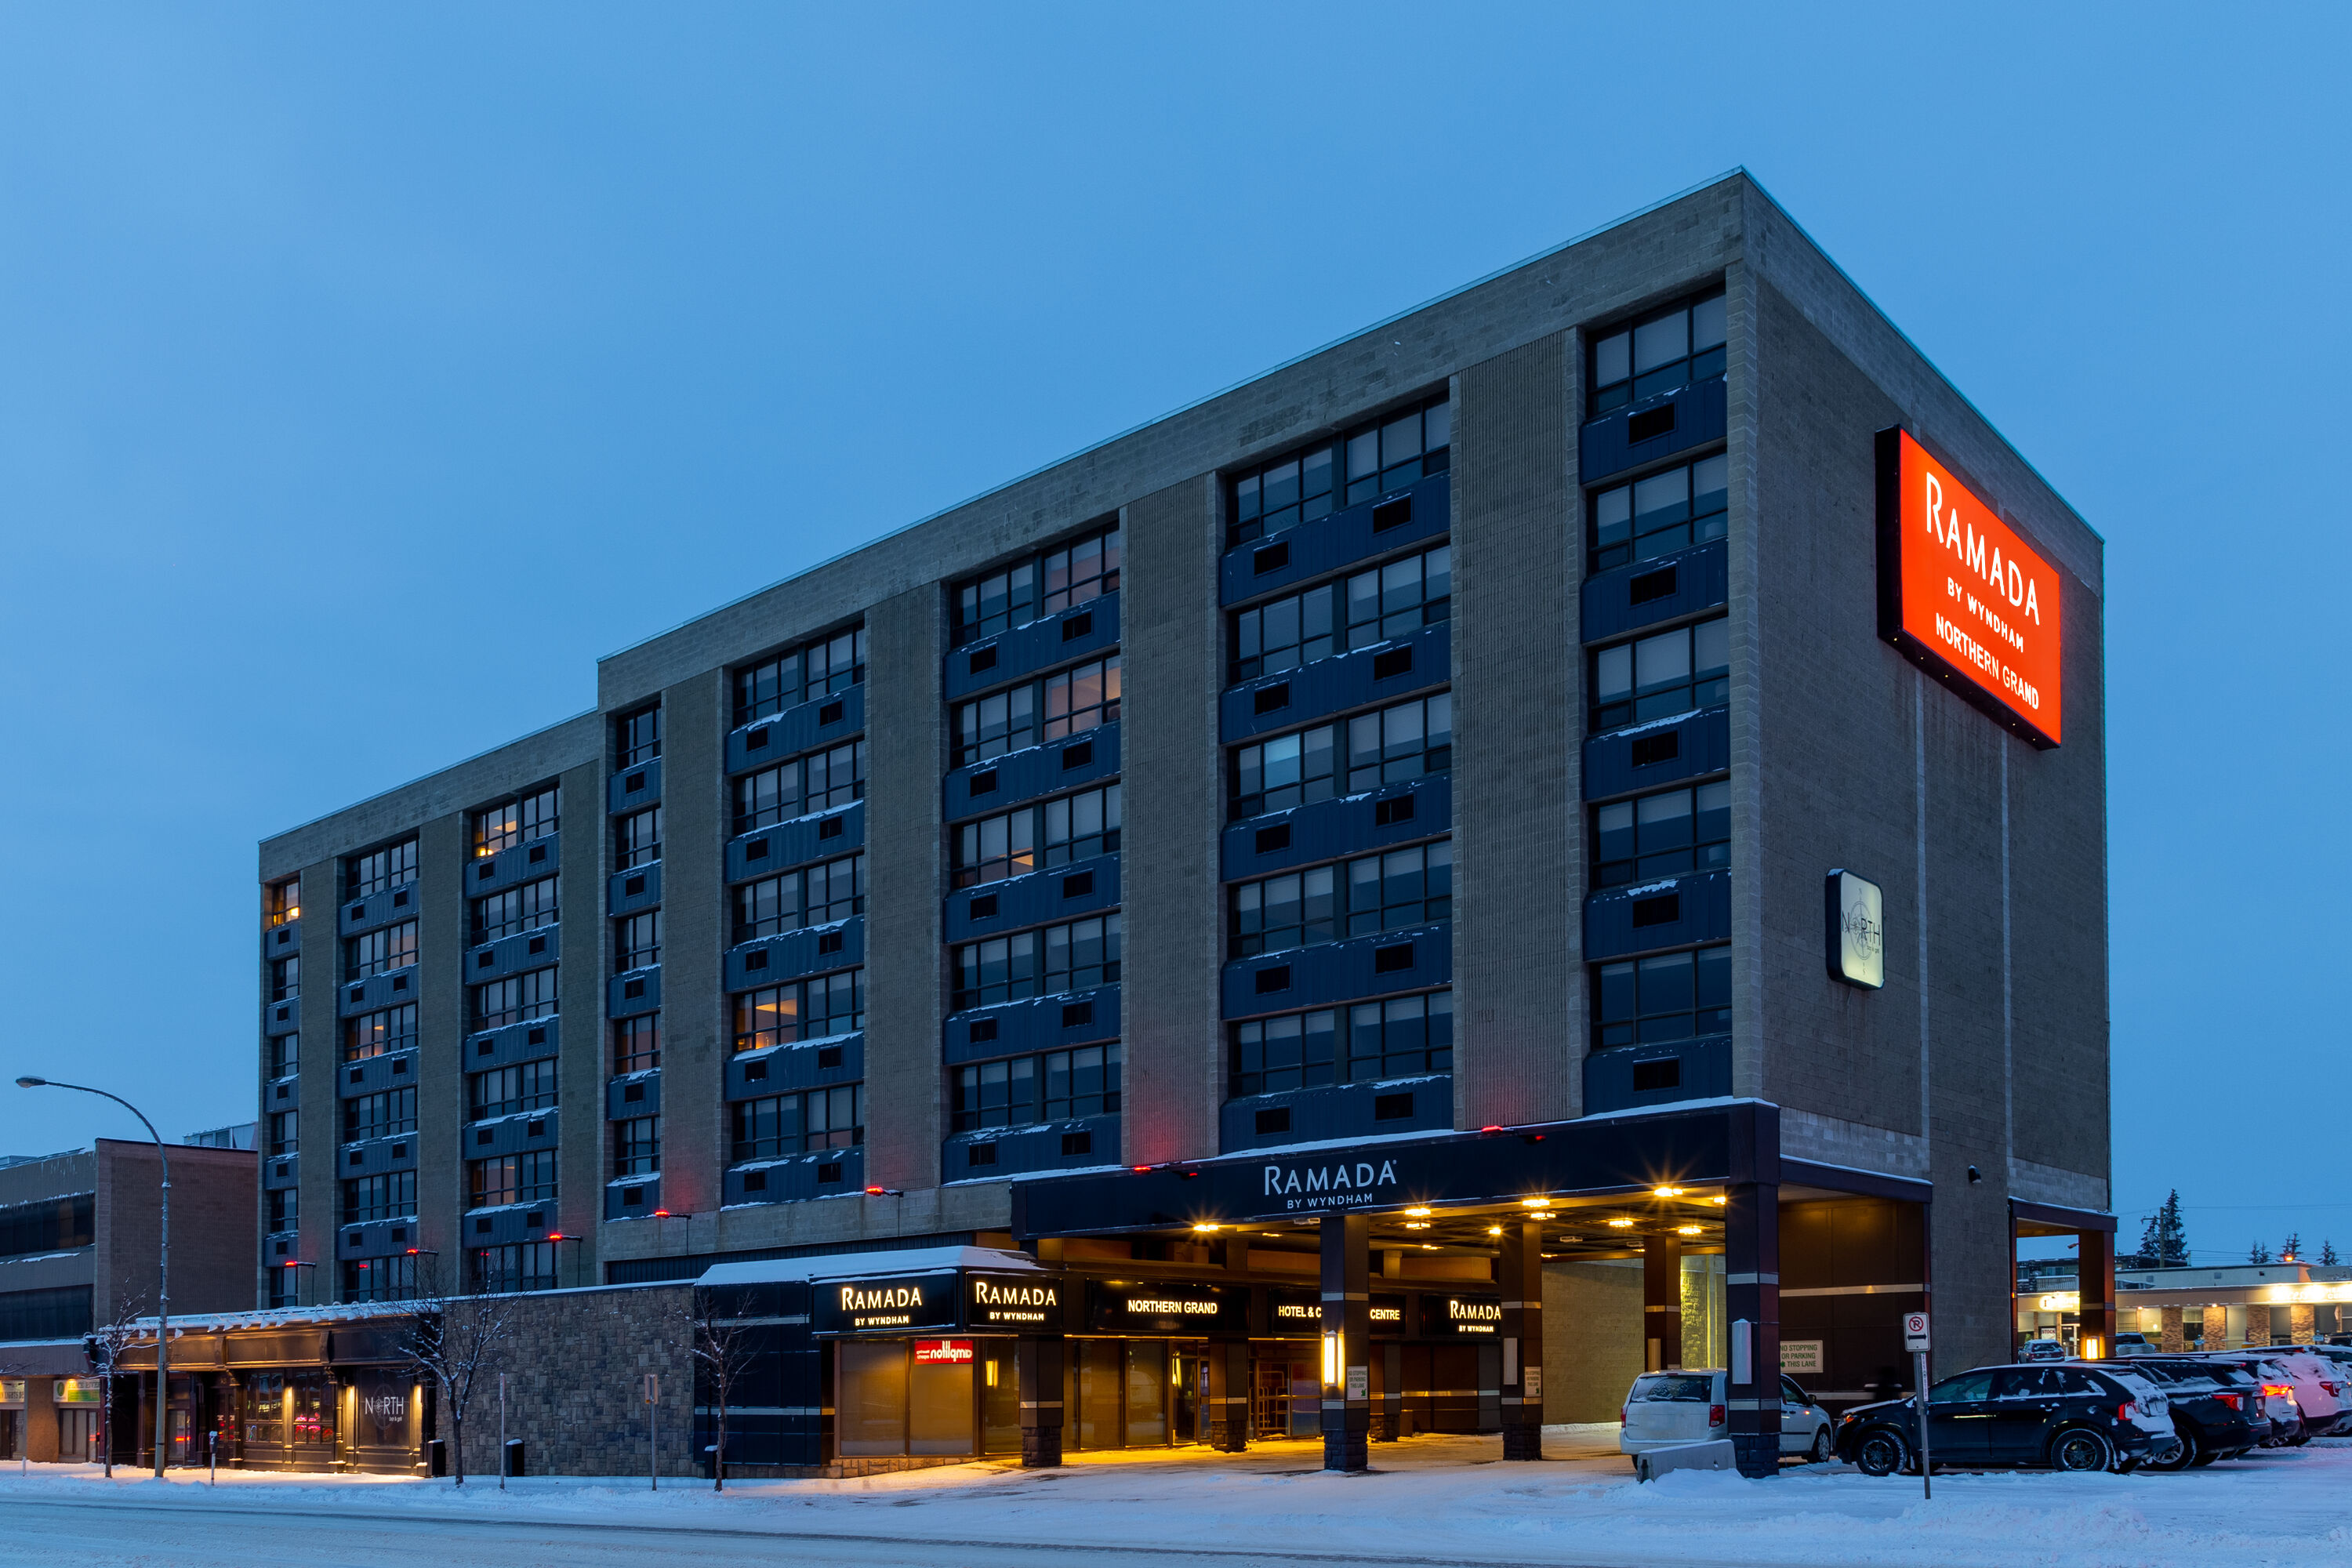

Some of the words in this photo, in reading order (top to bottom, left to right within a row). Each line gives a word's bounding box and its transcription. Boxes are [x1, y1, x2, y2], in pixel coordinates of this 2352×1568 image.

[1926, 471, 2040, 626] RAMADA
[1947, 577, 1962, 602] BY
[1968, 593, 2024, 652] WYNDHAM
[1936, 612, 1999, 680] NORTHERN
[2002, 666, 2039, 710] GRAND
[1265, 1160, 1397, 1196] RAMADA
[1287, 1199, 1301, 1209] BY
[1308, 1193, 1372, 1207] WYNDHAM
[842, 1287, 922, 1310] RAMADA
[976, 1282, 1056, 1305] RAMADA
[1004, 1312, 1044, 1320] WYNDHAM
[1128, 1300, 1181, 1313] NORTHERN
[1184, 1301, 1218, 1314] GRAND
[1278, 1305, 1306, 1317] HOTEL
[1308, 1306, 1314, 1317] &
[1370, 1308, 1400, 1320] CENTRE
[1450, 1300, 1501, 1319] RAMADA
[868, 1315, 909, 1325] WYNDHAM
